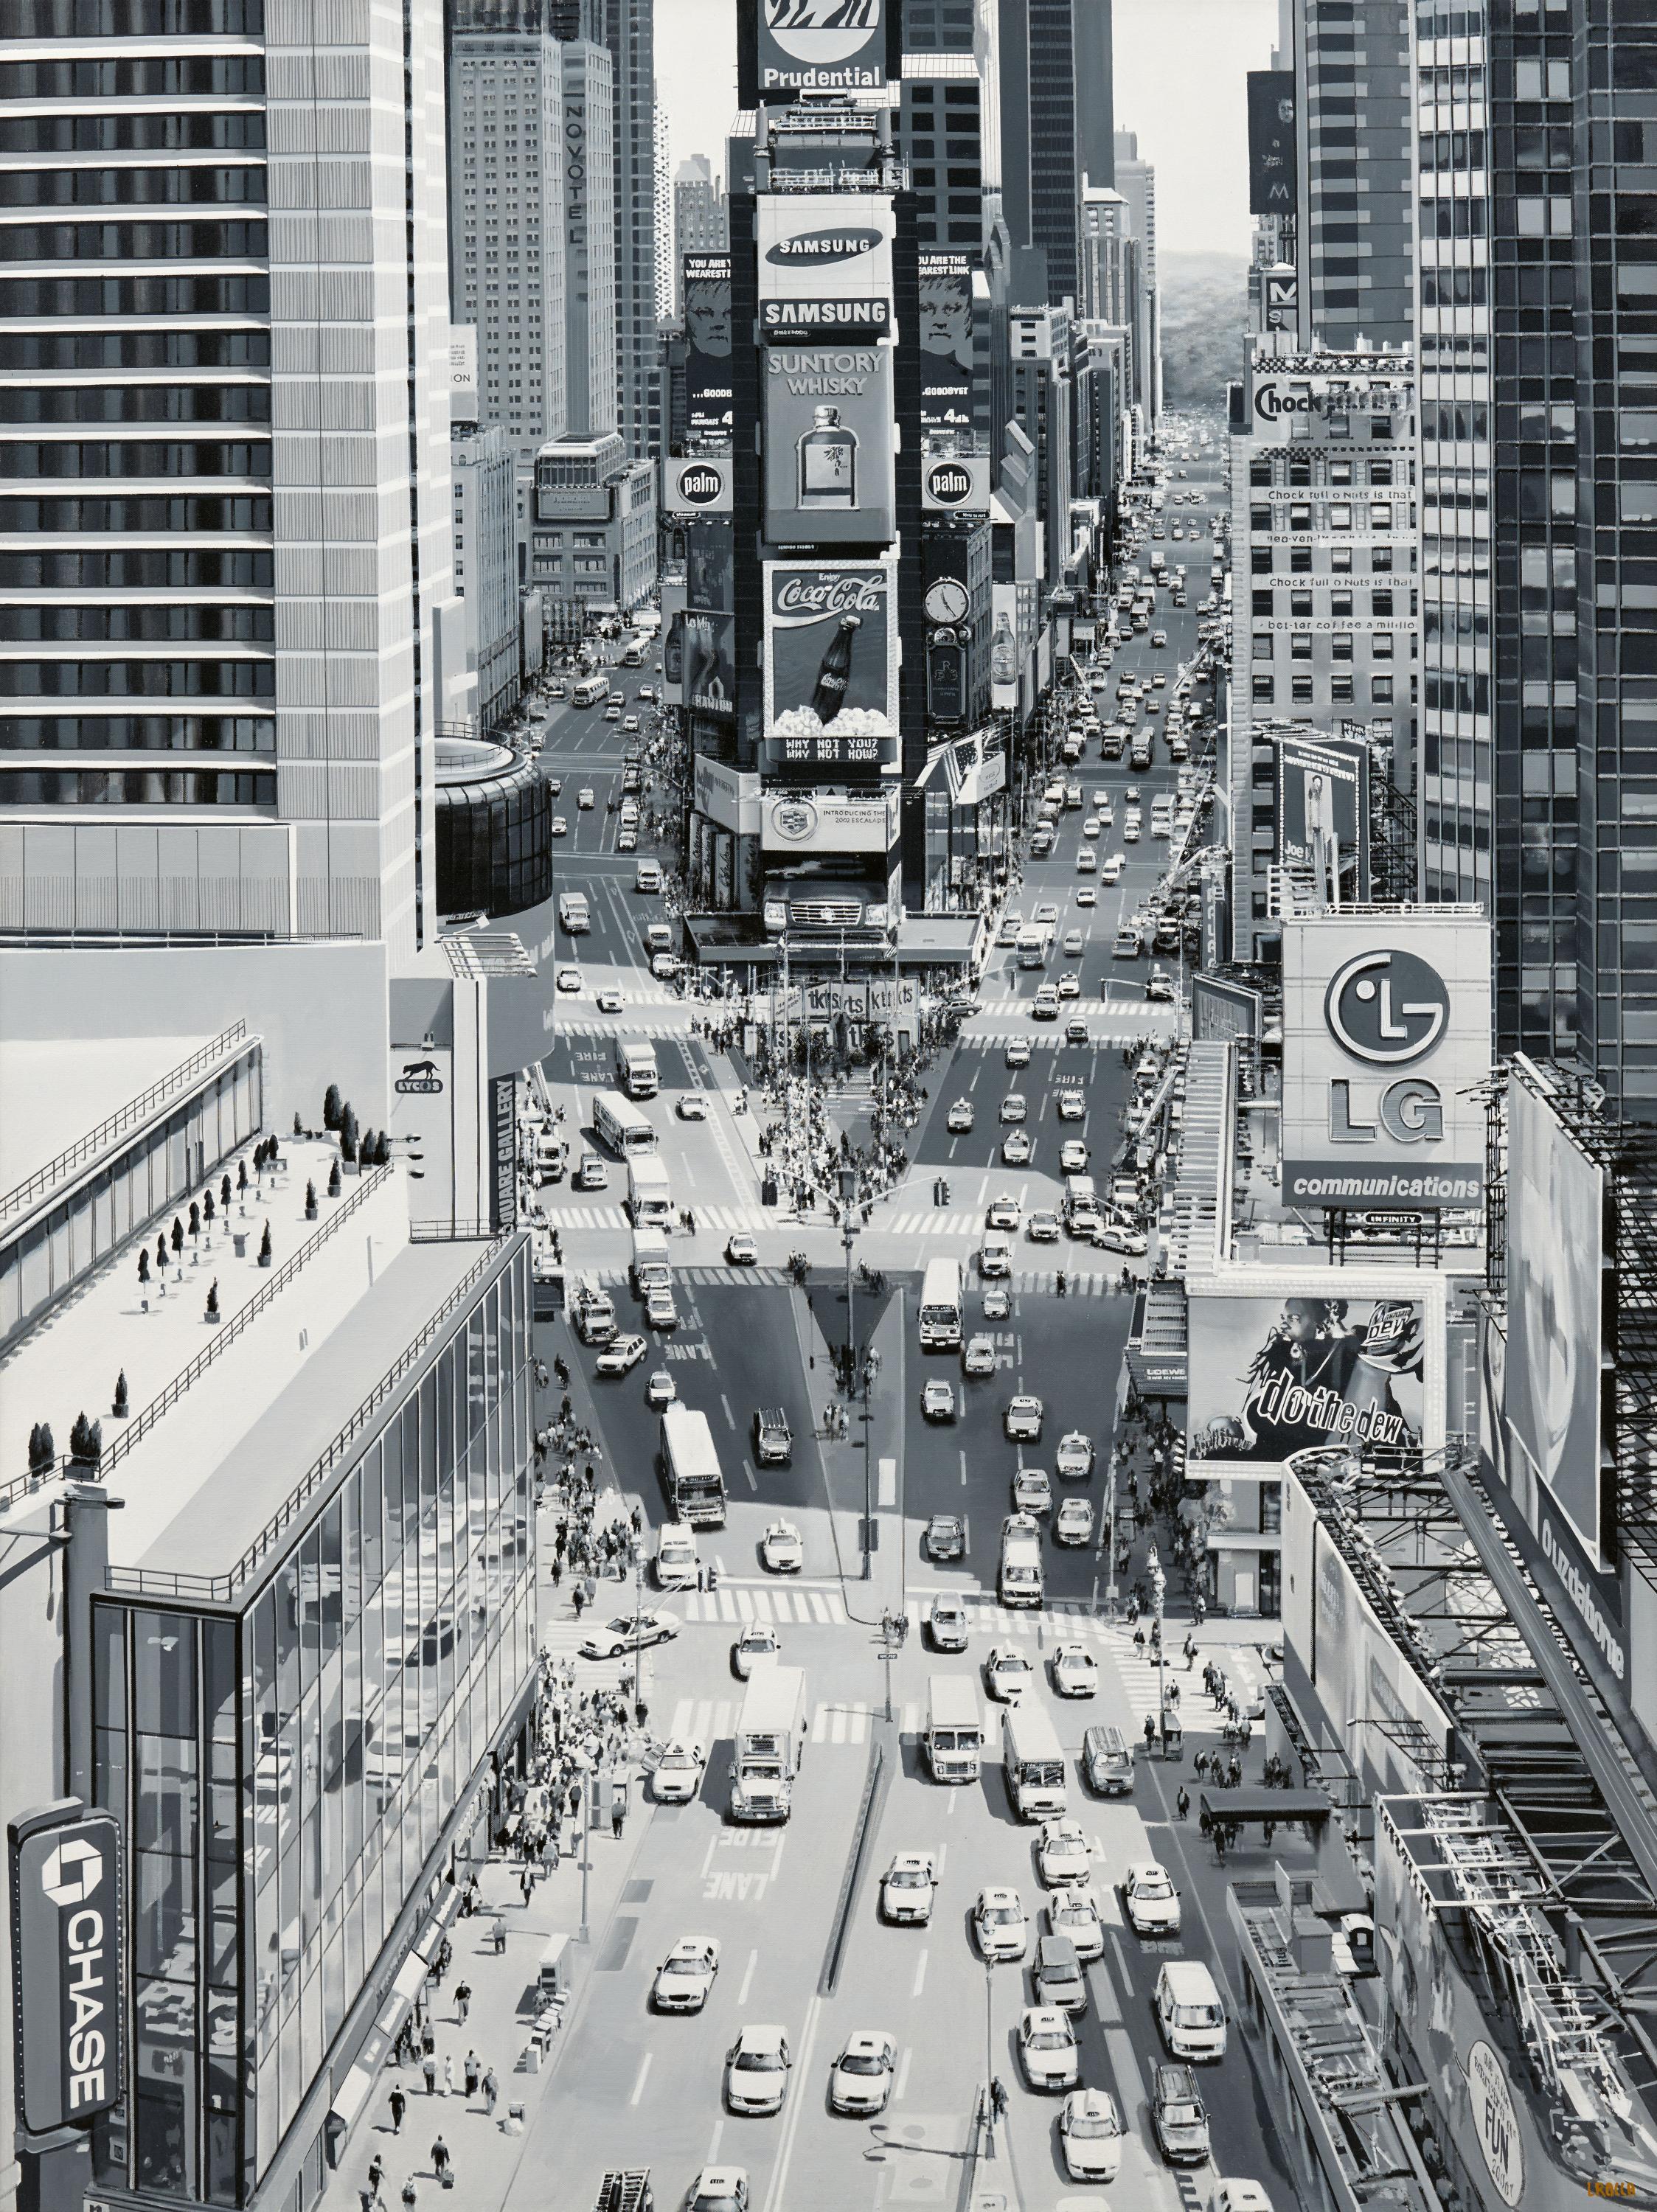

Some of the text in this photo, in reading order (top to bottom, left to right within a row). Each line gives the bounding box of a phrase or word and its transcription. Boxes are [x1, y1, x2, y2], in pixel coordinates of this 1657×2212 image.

[764, 66, 880, 87] Prudential
[566, 105, 583, 244] NOVOTEL
[779, 239, 869, 254] SAMSUNG
[689, 260, 726, 268] YOU ARE
[930, 256, 948, 265] ARE
[948, 256, 967, 264] THE
[765, 302, 886, 323] SAMSUNG
[768, 352, 885, 375] SUNTORY
[787, 377, 868, 395] WHISKY
[684, 472, 718, 495] palm
[933, 472, 968, 495] palm
[1268, 490, 1304, 500] Chock
[1374, 491, 1383, 499] is
[819, 573, 841, 581] Enjoy
[1270, 578, 1306, 587] Chock
[1344, 578, 1369, 586] Nuts
[786, 739, 878, 749] WHY NOT YOU?
[786, 749, 878, 759] WHY NOT HOW?
[1285, 840, 1305, 858] Joe
[576, 1051, 607, 1062] FIRE
[398, 1080, 440, 1091] LYCOS
[580, 1072, 615, 1082] LANE
[1055, 1074, 1084, 1085] FIRE
[1329, 1077, 1445, 1142] LG
[497, 1080, 516, 1230] QUARE GALLERY
[1294, 1175, 1479, 1198] communications
[664, 1343, 709, 1360] LANE
[1355, 1397, 1403, 1444] dew
[703, 1871, 768, 1900] LANE
[67, 1908, 105, 2110] CHASE
[1485, 2097, 1509, 2174] FUN
